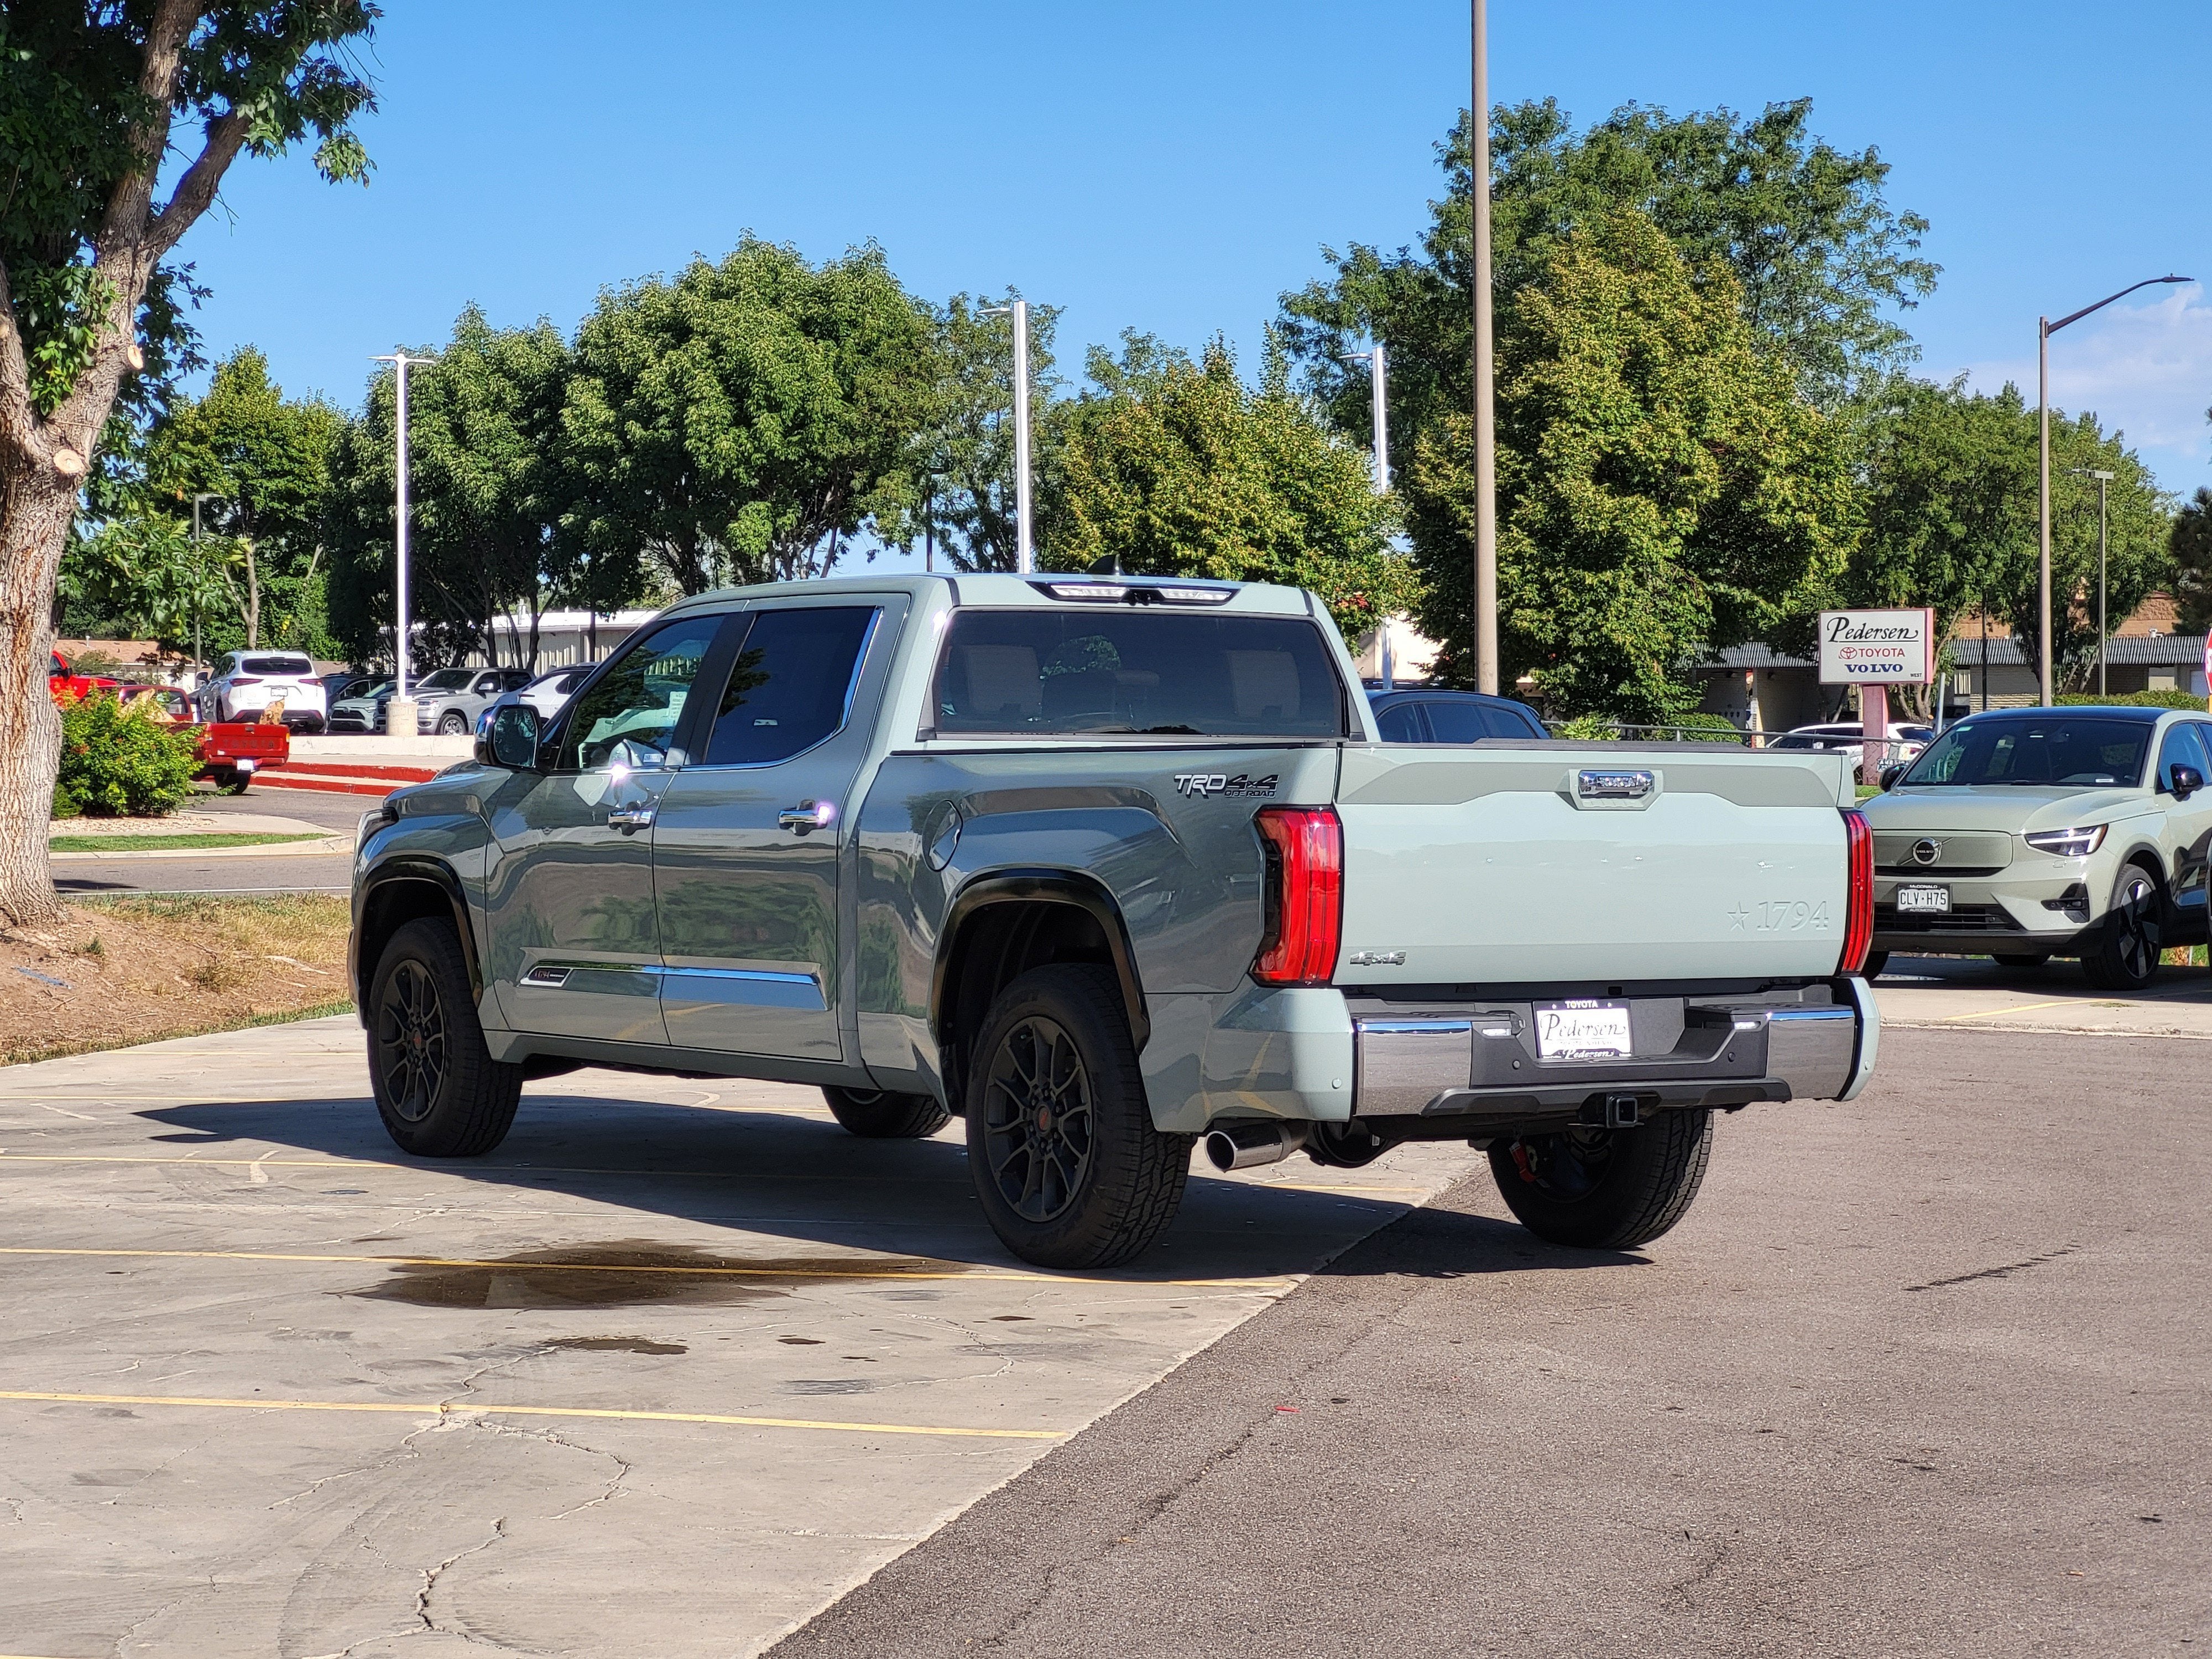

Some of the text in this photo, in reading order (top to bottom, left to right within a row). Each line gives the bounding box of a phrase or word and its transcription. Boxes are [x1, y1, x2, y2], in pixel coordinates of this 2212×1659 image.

[1827, 617, 1918, 643] Pedersen
[1858, 648, 1906, 658] TOYOTA
[1844, 664, 1903, 673] VOLVO
[1174, 774, 1227, 799] TRD
[1757, 901, 1829, 931] 1794
[1565, 1000, 1598, 1009] TOYOTA
[1541, 1013, 1626, 1041] Pedersen
[1562, 1049, 1615, 1060] Pedersen
